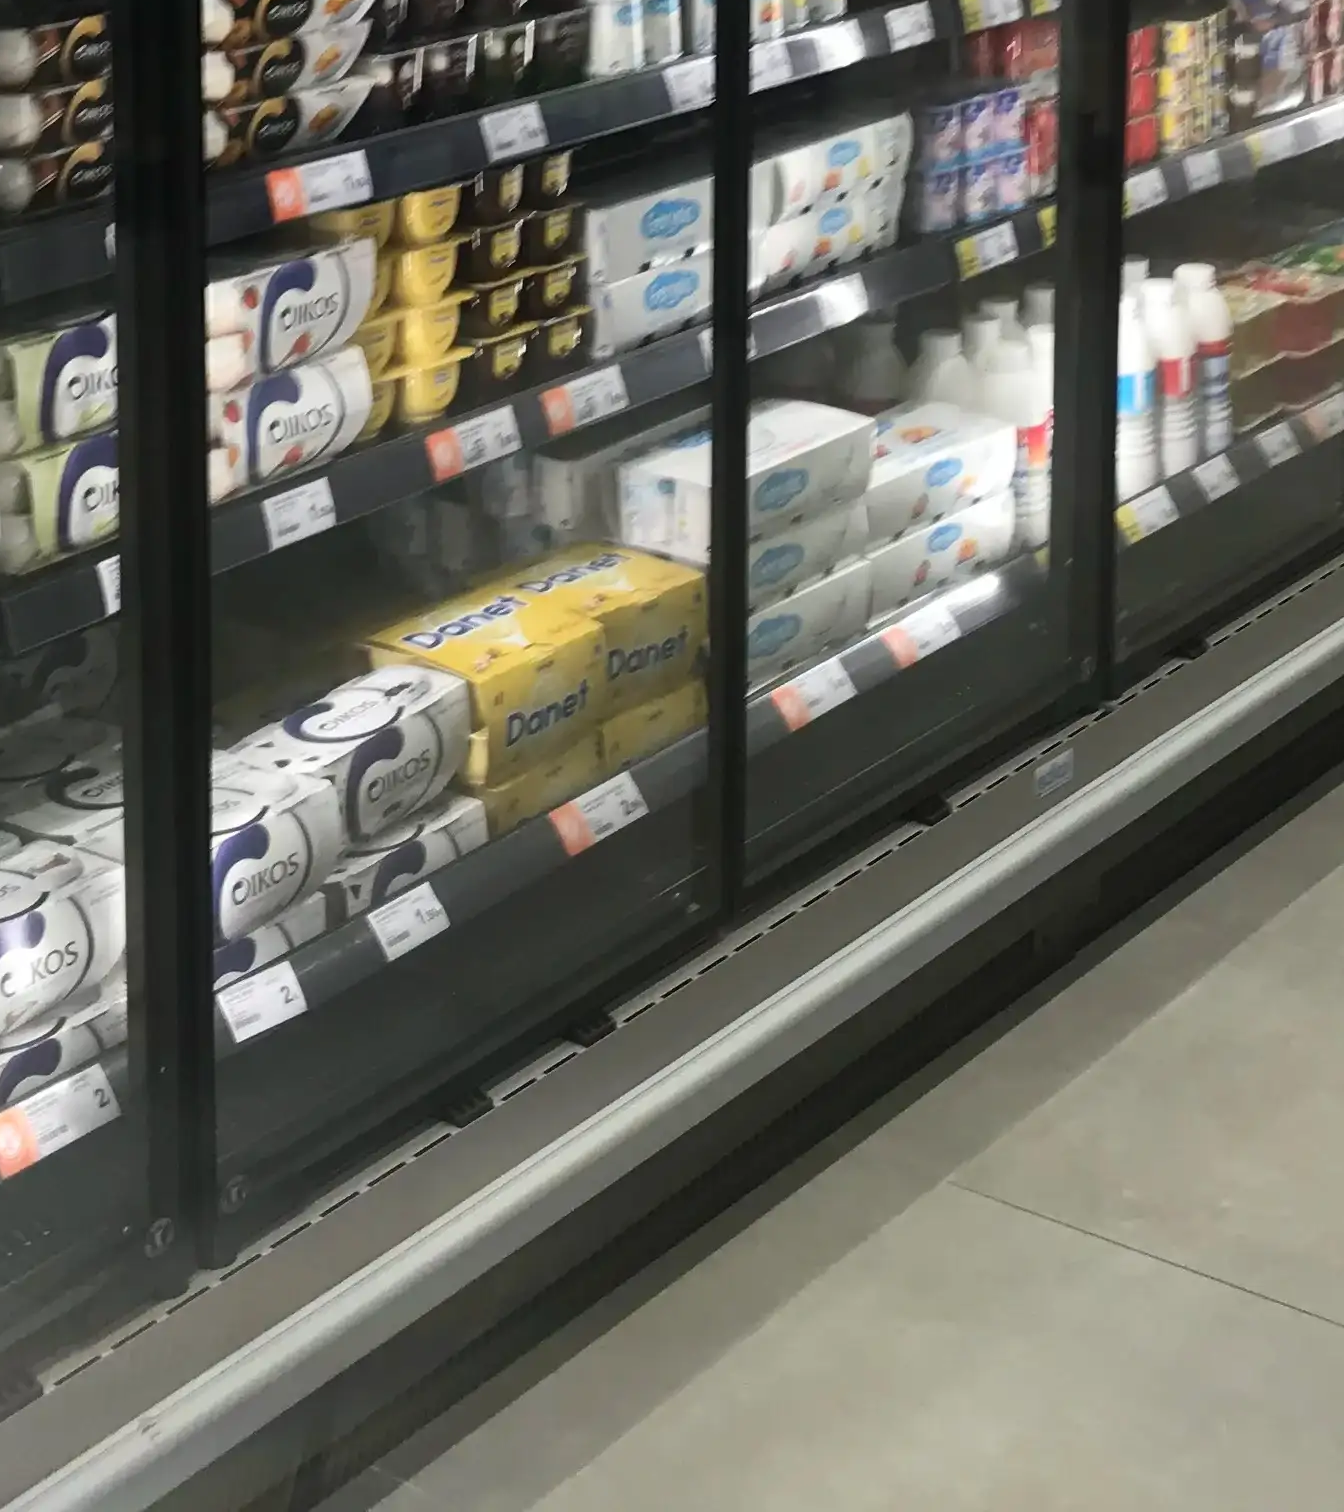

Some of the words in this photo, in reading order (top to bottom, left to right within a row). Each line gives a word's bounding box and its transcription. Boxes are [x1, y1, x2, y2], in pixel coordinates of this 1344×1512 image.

[278, 291, 340, 330] OIKOS
[521, 550, 632, 596] Danet
[403, 592, 526, 651] Danet
[607, 626, 691, 680] Danet
[505, 681, 590, 748] Danet
[367, 747, 431, 803] OIKOS
[231, 852, 300, 906] OIKOS
[0, 940, 80, 1000] OKOS
